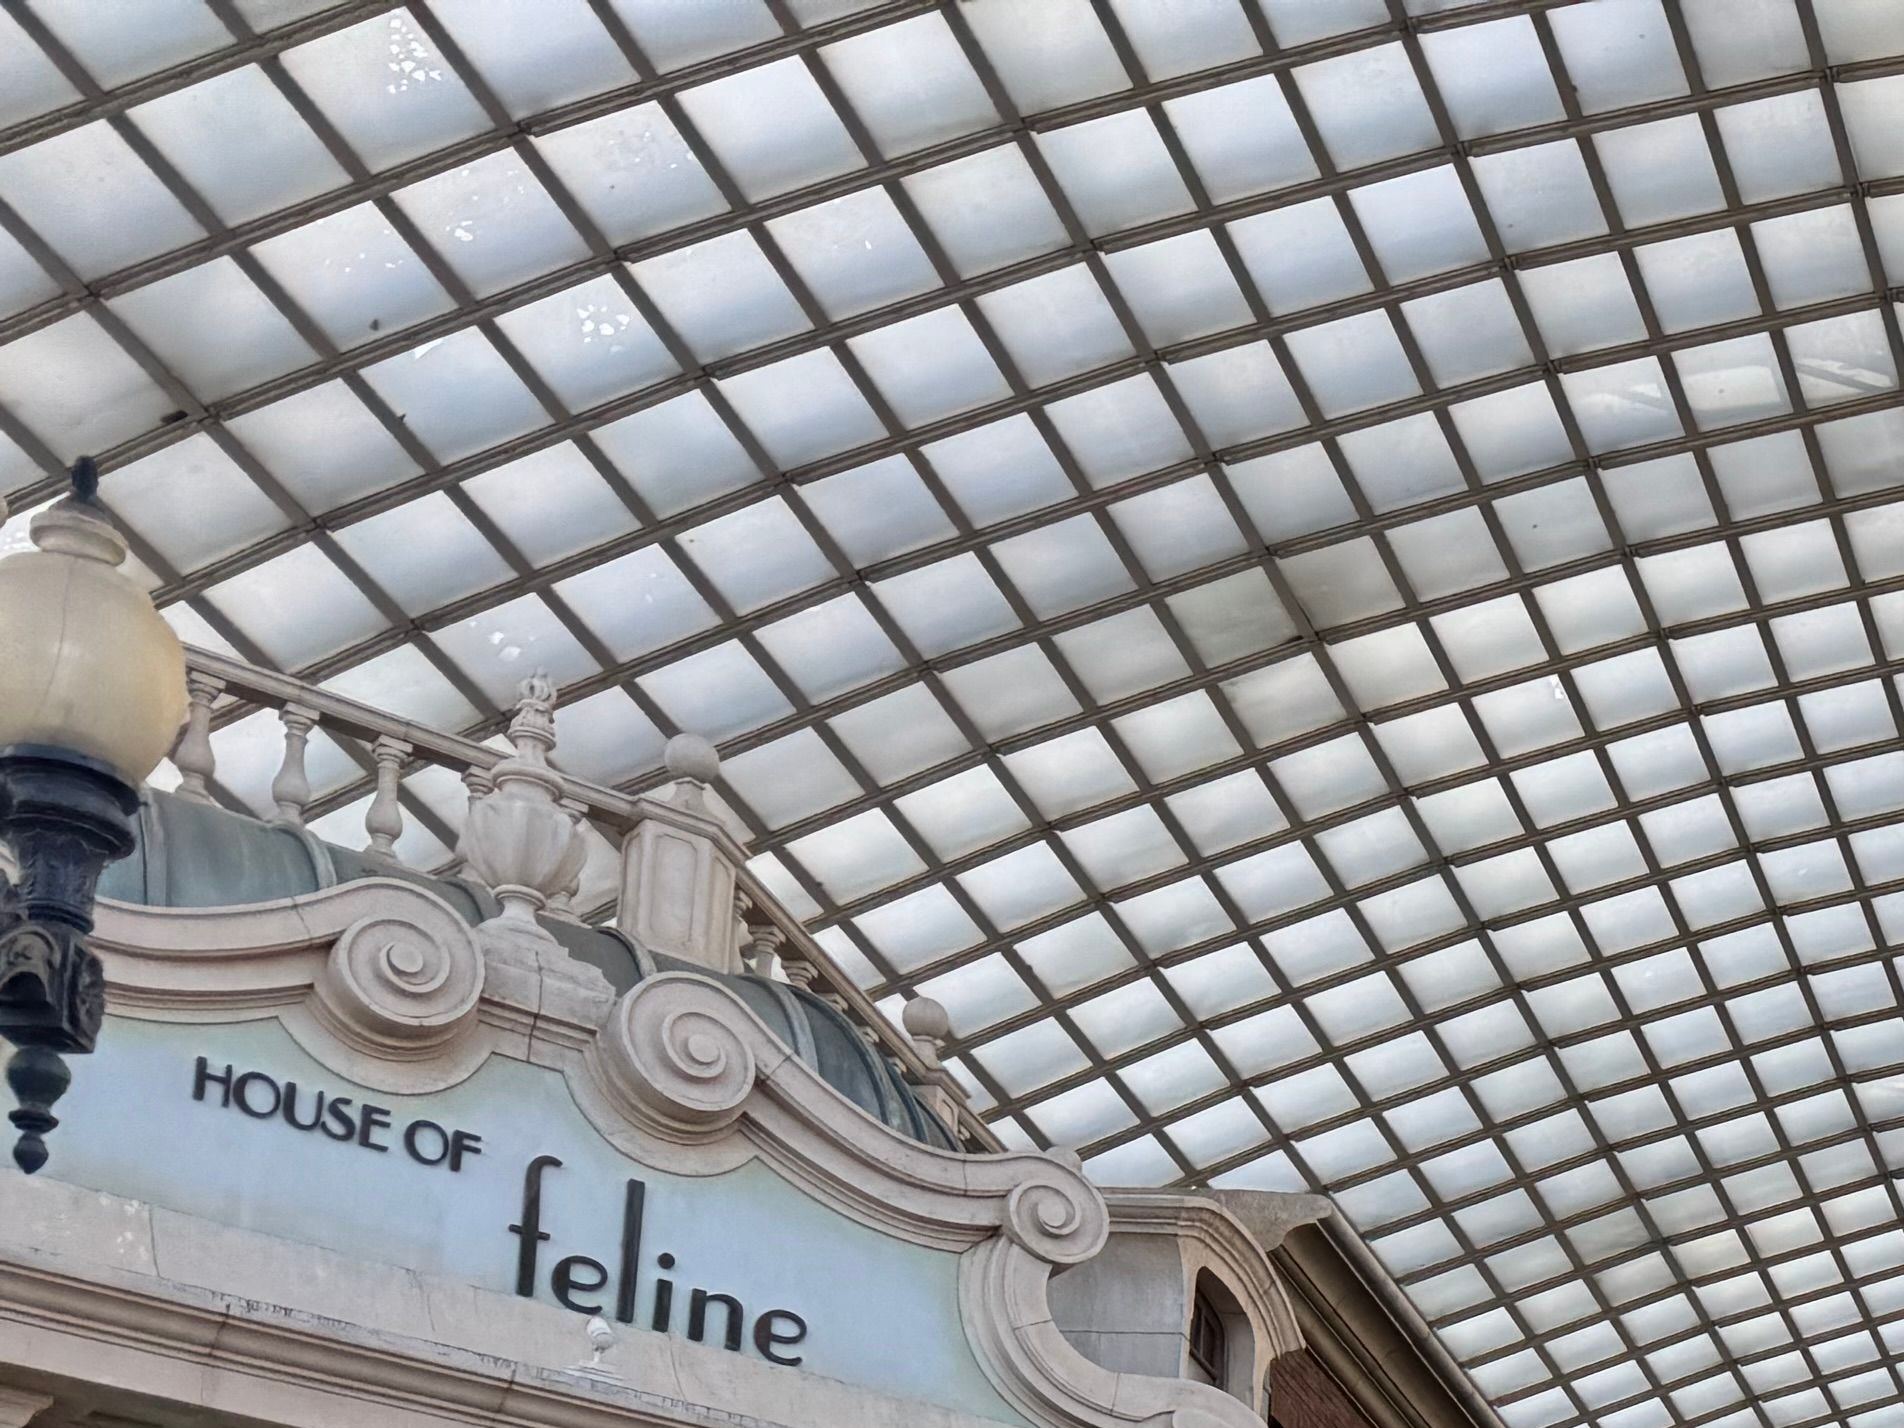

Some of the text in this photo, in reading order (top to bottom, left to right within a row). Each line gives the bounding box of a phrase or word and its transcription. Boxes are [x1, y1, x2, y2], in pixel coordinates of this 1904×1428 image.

[192, 1055, 483, 1173] HOUSE OF
[508, 1154, 808, 1367] feline
